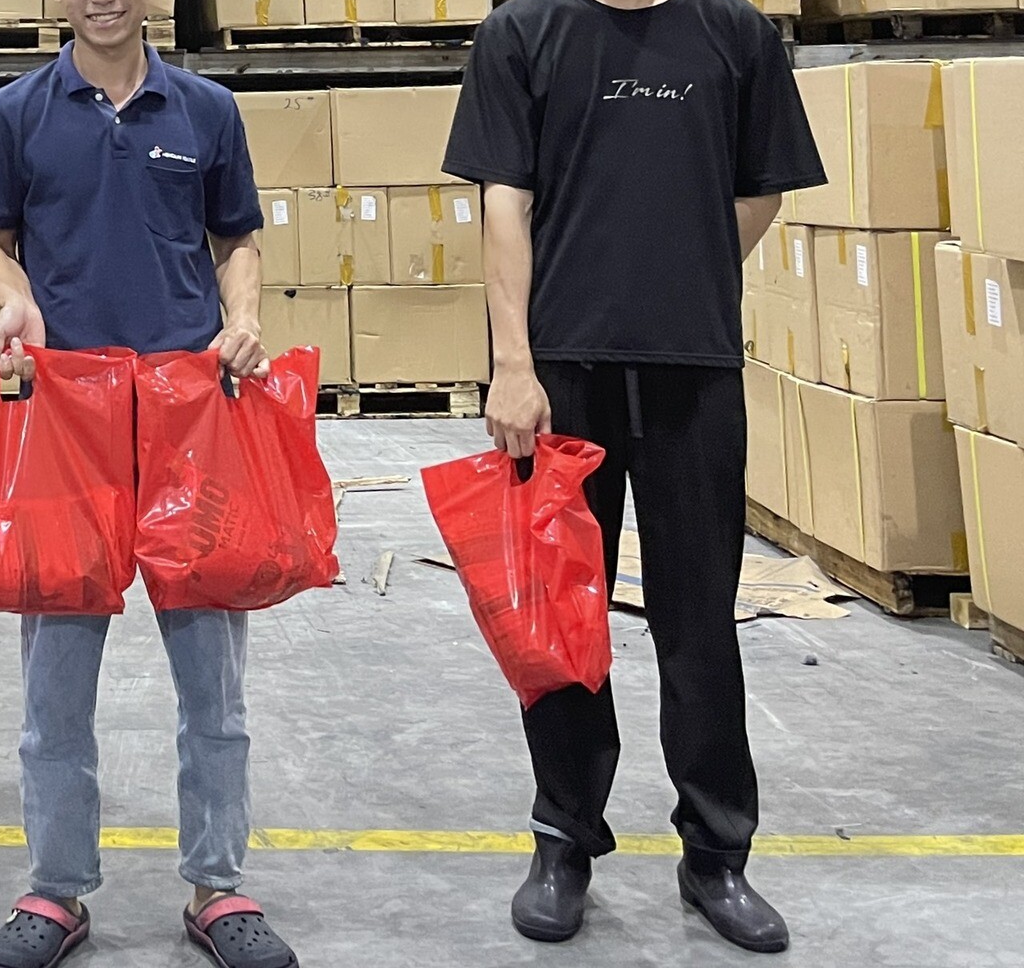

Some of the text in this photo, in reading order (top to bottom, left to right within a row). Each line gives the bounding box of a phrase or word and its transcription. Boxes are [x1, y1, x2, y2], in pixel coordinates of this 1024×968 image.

[602, 78, 694, 101] I'm in!
[189, 478, 230, 557] OMO
